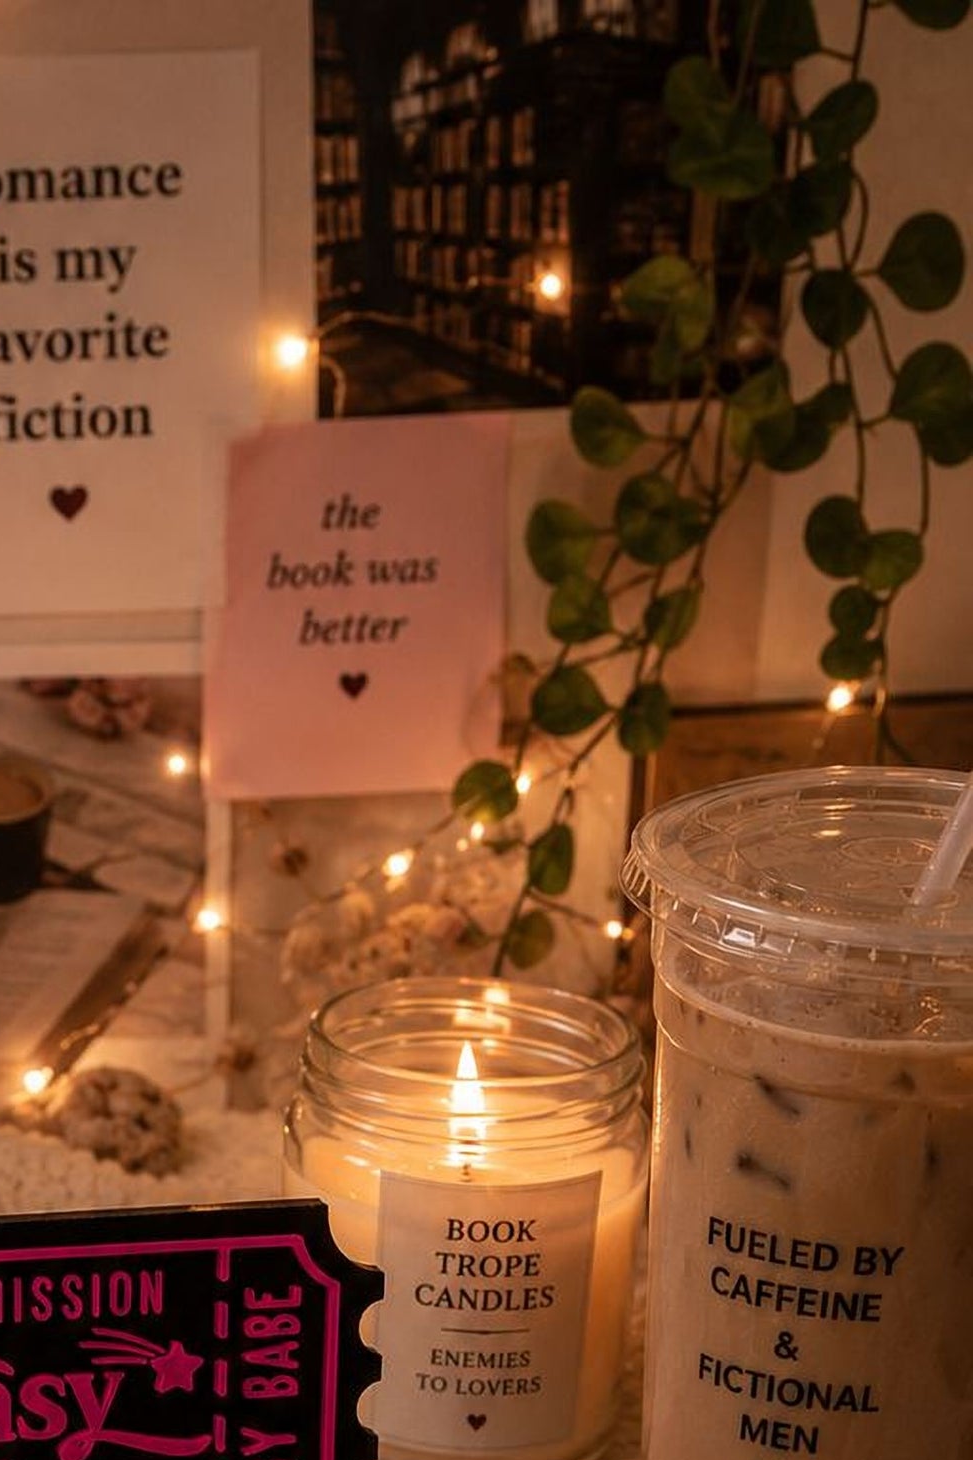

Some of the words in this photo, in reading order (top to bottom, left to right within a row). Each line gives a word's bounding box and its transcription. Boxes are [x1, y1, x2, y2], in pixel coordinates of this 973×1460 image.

[53, 241, 137, 294] my
[320, 493, 380, 531] the
[265, 552, 354, 590] book
[366, 556, 439, 586] was
[298, 608, 409, 647] better
[446, 1218, 537, 1243] BOOK
[707, 1216, 840, 1273] FUELED
[853, 1245, 906, 1279] BY
[434, 1251, 542, 1279] TROPE
[414, 1283, 556, 1312] CANDLES
[709, 1268, 883, 1322] CAFFEINE
[241, 1283, 303, 1401] BABE
[429, 1347, 532, 1369] ENEMIES
[774, 1331, 800, 1362] &
[416, 1372, 448, 1393] TO
[455, 1374, 542, 1397] LOVERS
[698, 1353, 880, 1414] FICTIONAL
[739, 1413, 820, 1455] MEN
